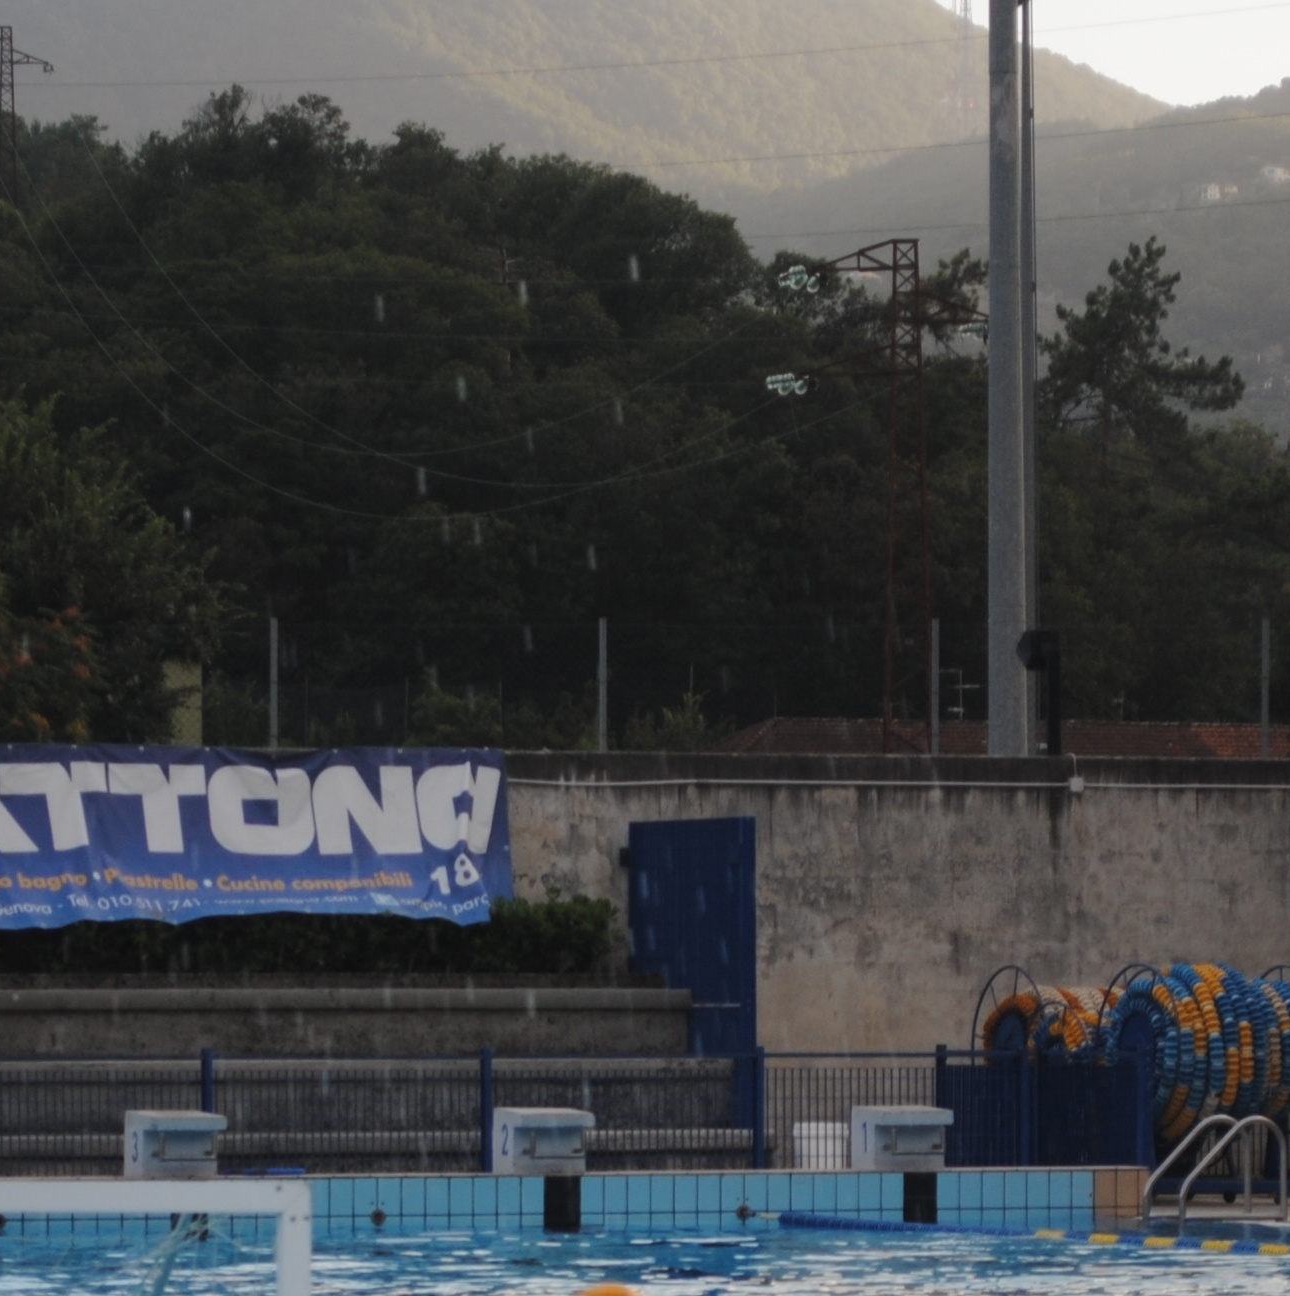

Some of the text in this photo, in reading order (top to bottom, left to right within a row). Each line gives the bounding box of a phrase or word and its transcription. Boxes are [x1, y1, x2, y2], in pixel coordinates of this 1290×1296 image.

[16, 871, 88, 892] bagno
[216, 875, 286, 892] Cucine
[131, 1131, 139, 1163] 3
[501, 1123, 509, 1157] 2
